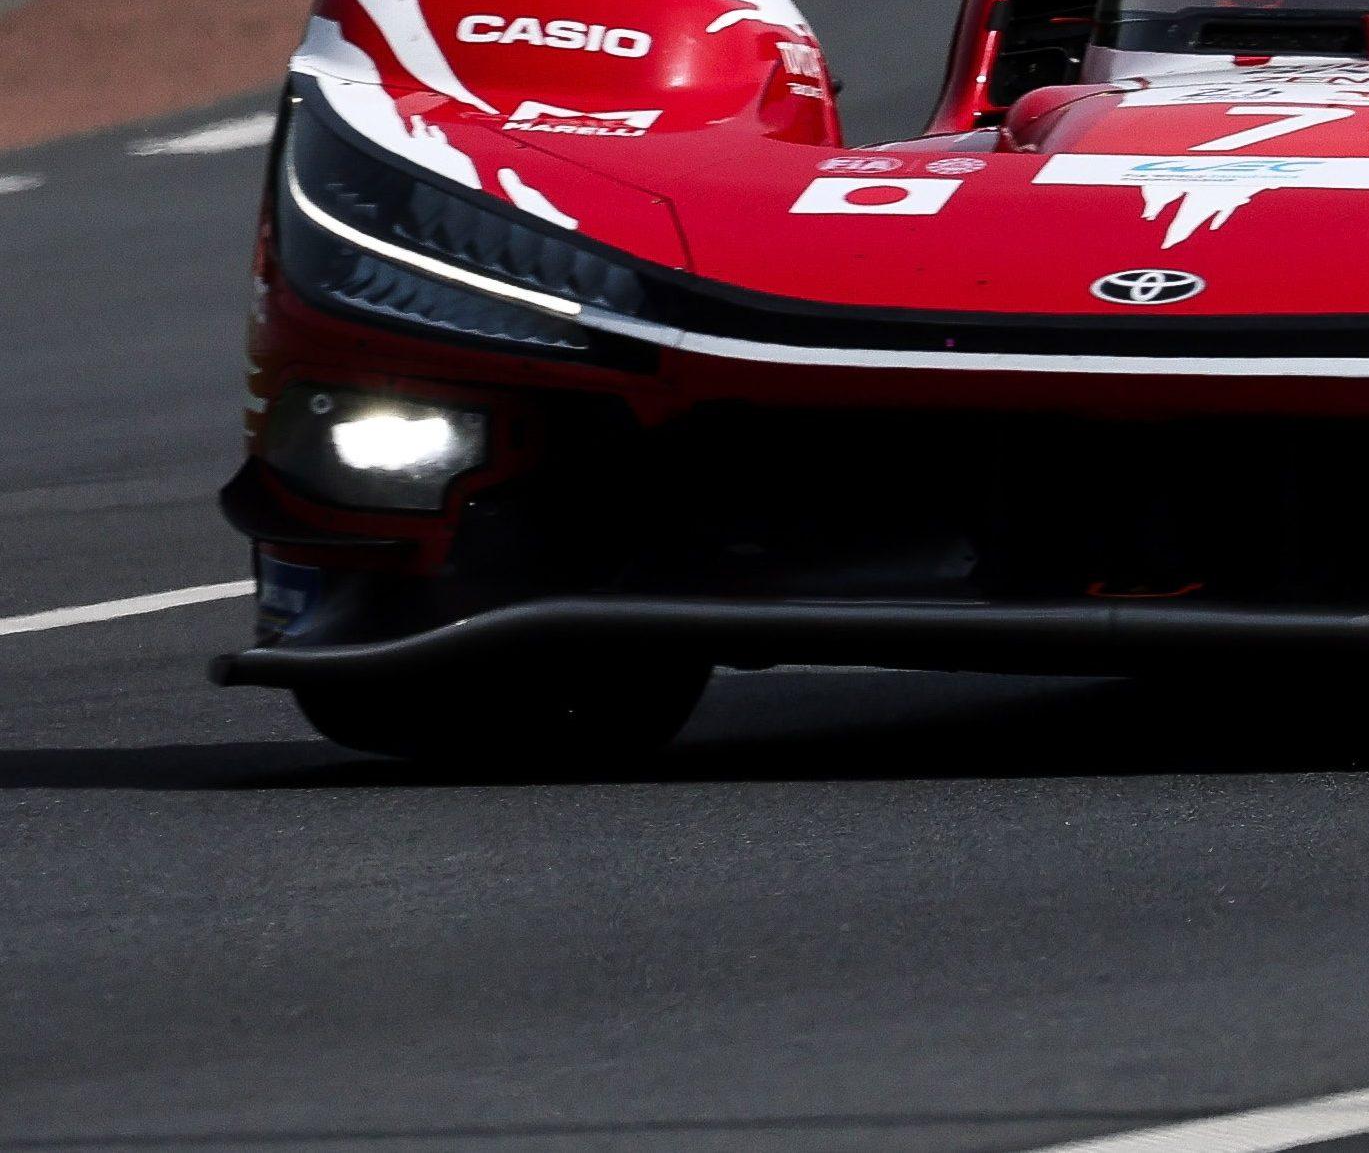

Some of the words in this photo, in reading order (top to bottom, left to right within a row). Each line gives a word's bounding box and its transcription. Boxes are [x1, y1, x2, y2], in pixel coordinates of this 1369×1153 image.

[456, 14, 652, 58] CASIO
[502, 121, 646, 137] MARELLI
[1187, 105, 1356, 152] 7
